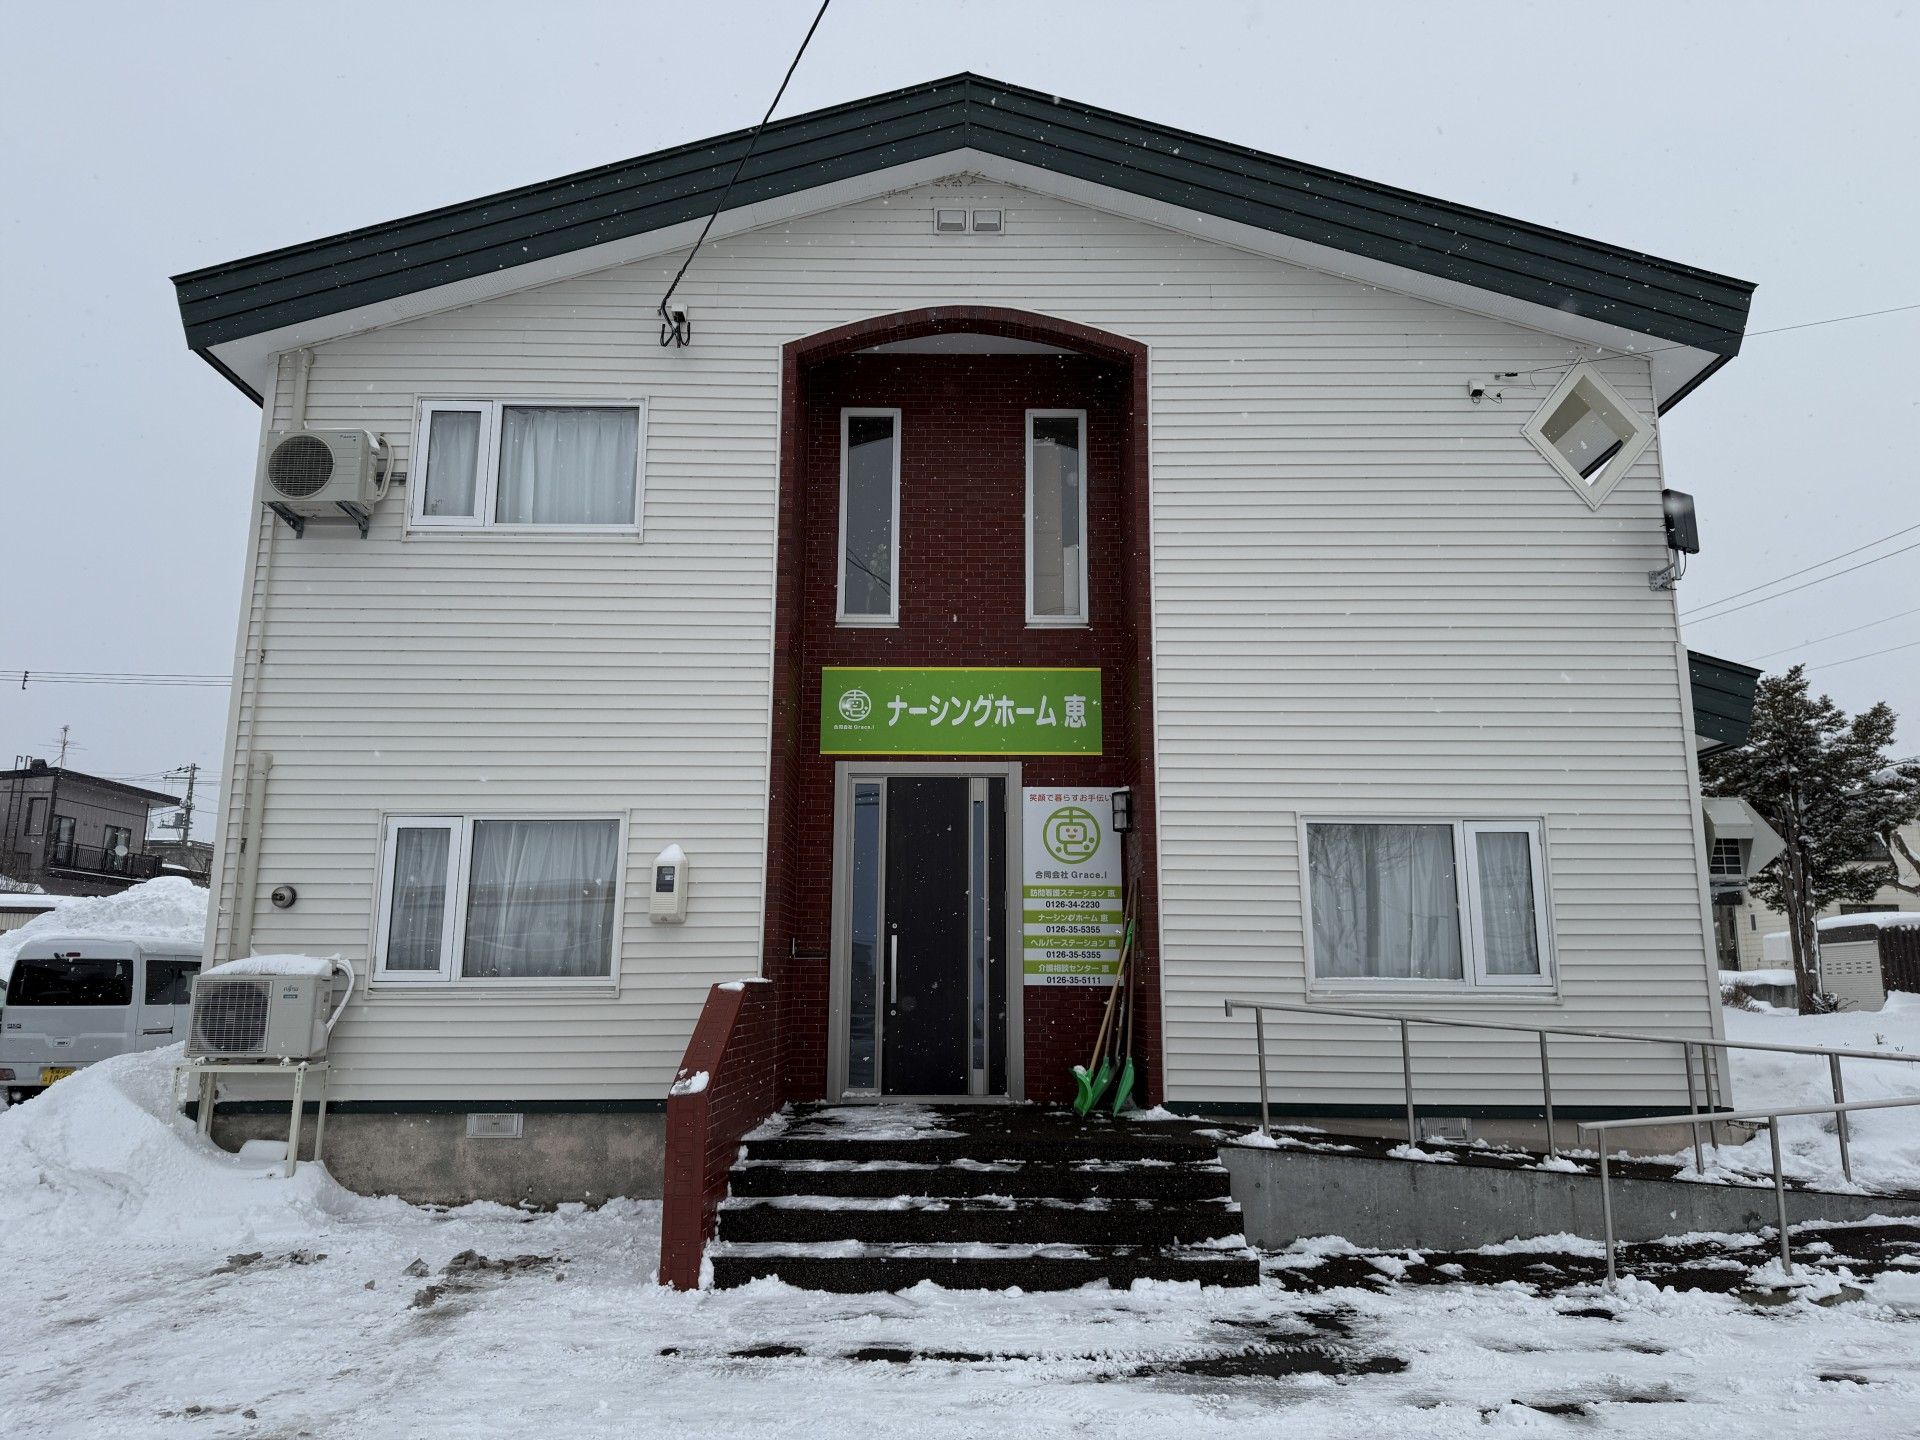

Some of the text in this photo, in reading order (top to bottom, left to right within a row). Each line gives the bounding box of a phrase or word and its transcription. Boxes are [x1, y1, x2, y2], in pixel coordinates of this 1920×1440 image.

[887, 693, 1087, 728] ナーシングホーム 恵
[1035, 870, 1069, 879] 合同会社
[1045, 900, 1100, 909] 0126-34-2230
[1045, 925, 1101, 934] 0126-35-5355
[1046, 950, 1101, 959] 0126-35-5355
[1046, 976, 1101, 984] 0126-35-5111
